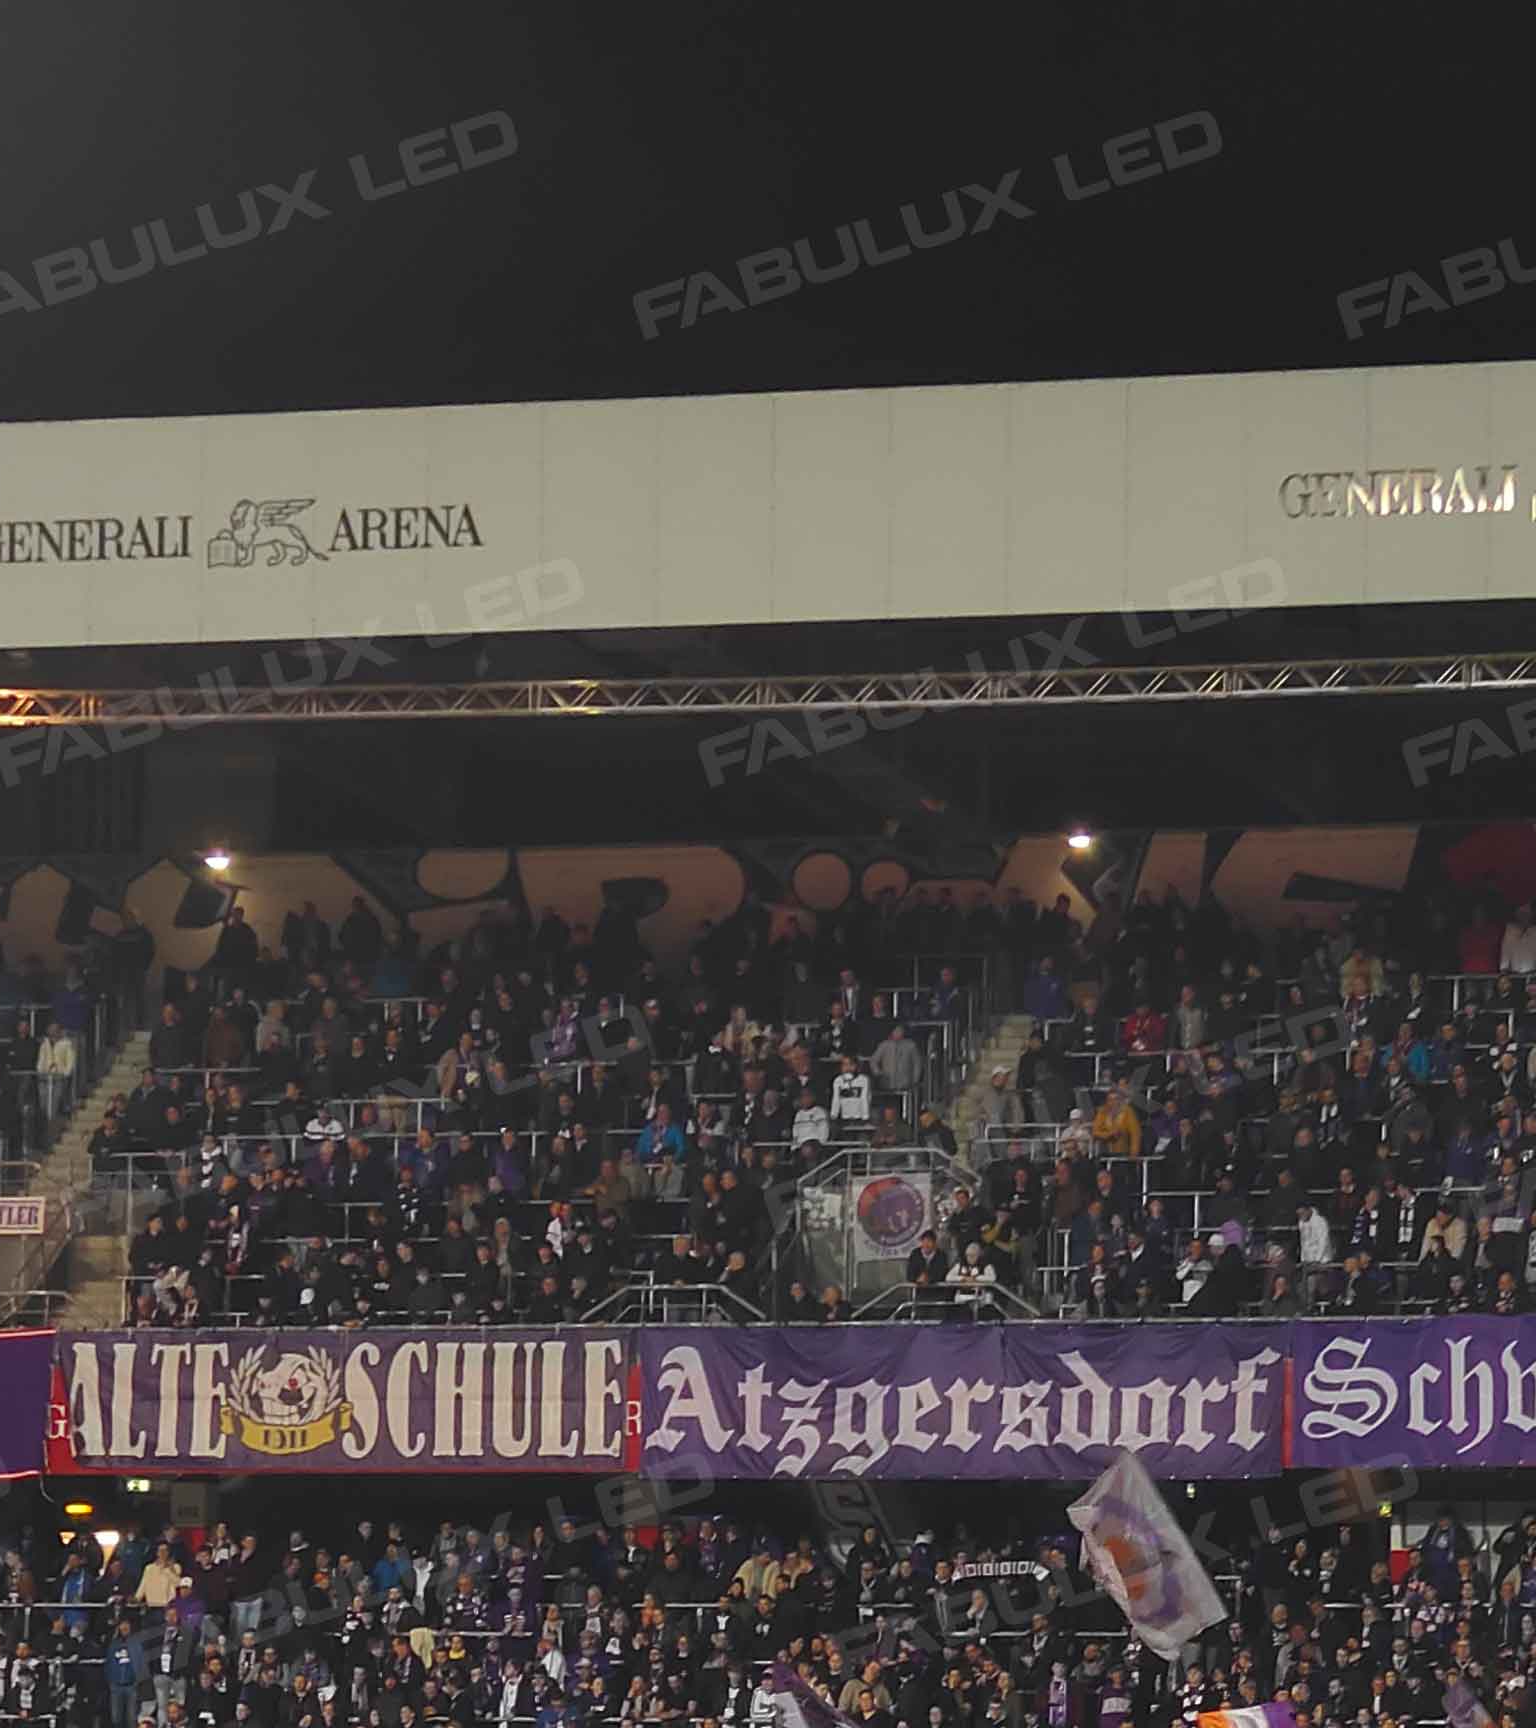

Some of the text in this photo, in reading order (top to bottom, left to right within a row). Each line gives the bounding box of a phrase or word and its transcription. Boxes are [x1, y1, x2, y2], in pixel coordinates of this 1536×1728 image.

[328, 503, 484, 554] ARENA
[1277, 463, 1519, 520] GENERALI
[68, 1338, 624, 1462] ALTE SCHULE
[645, 1343, 1282, 1478] Atzgersdorf
